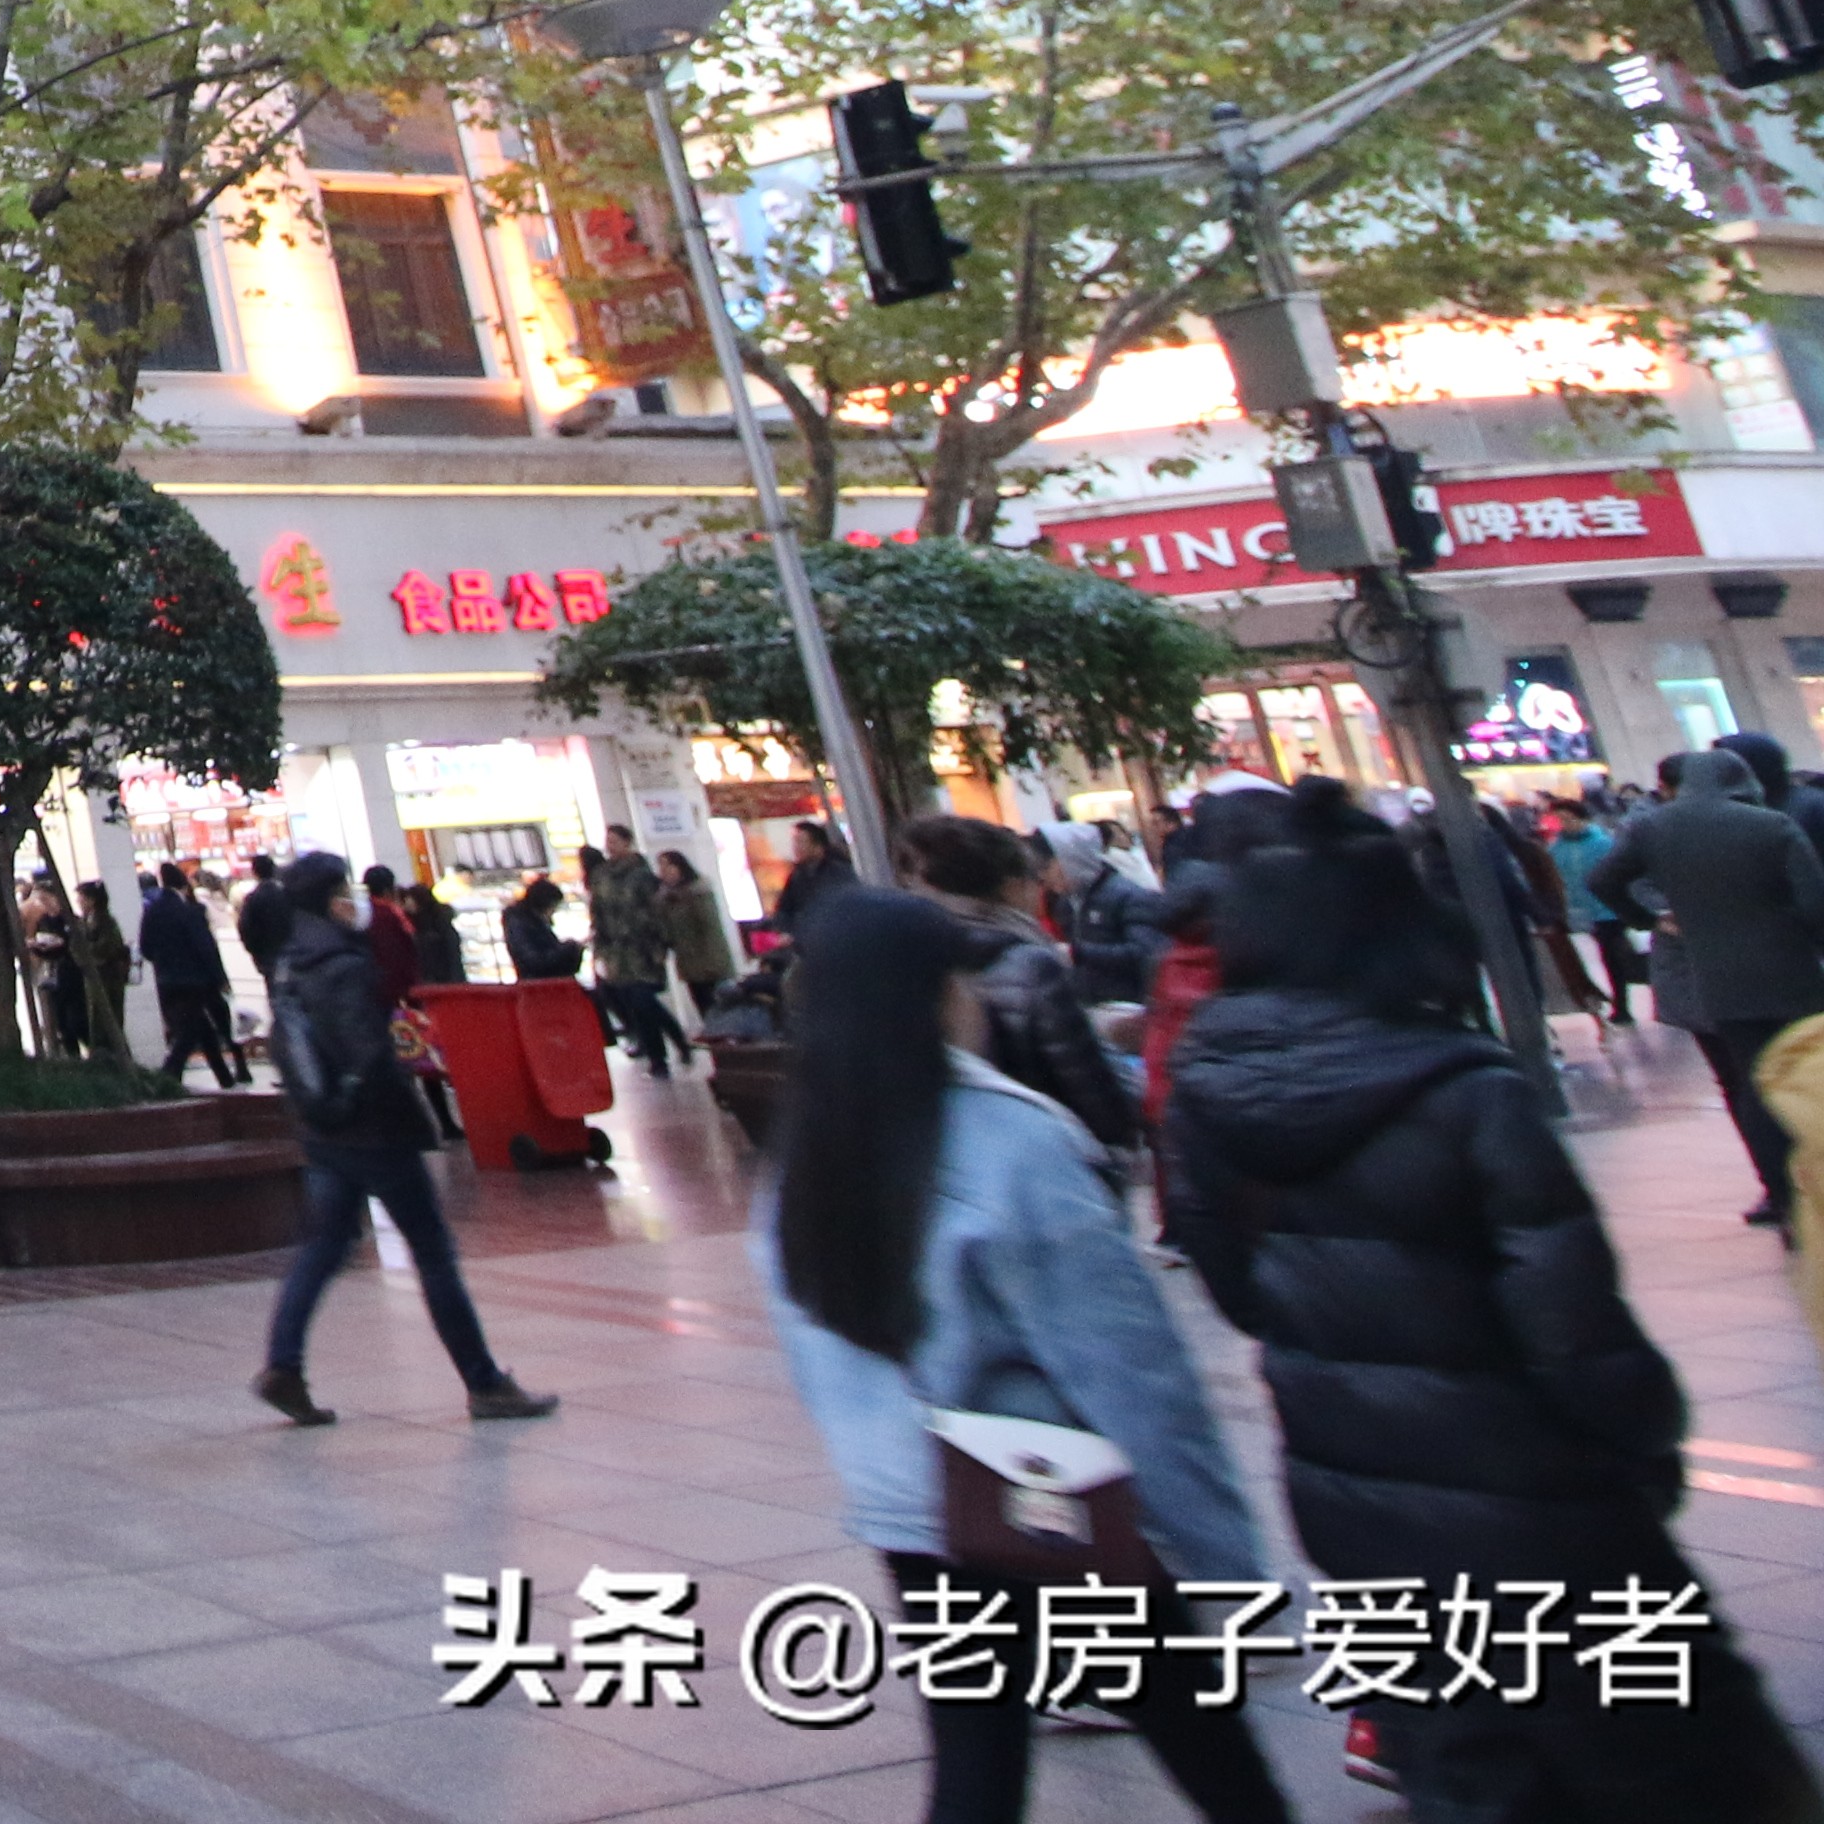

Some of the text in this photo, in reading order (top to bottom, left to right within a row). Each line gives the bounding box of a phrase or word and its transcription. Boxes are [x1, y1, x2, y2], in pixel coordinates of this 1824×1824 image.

[1450, 496, 1649, 546] 牌珠宝
[266, 538, 612, 636] 生 食品公司
